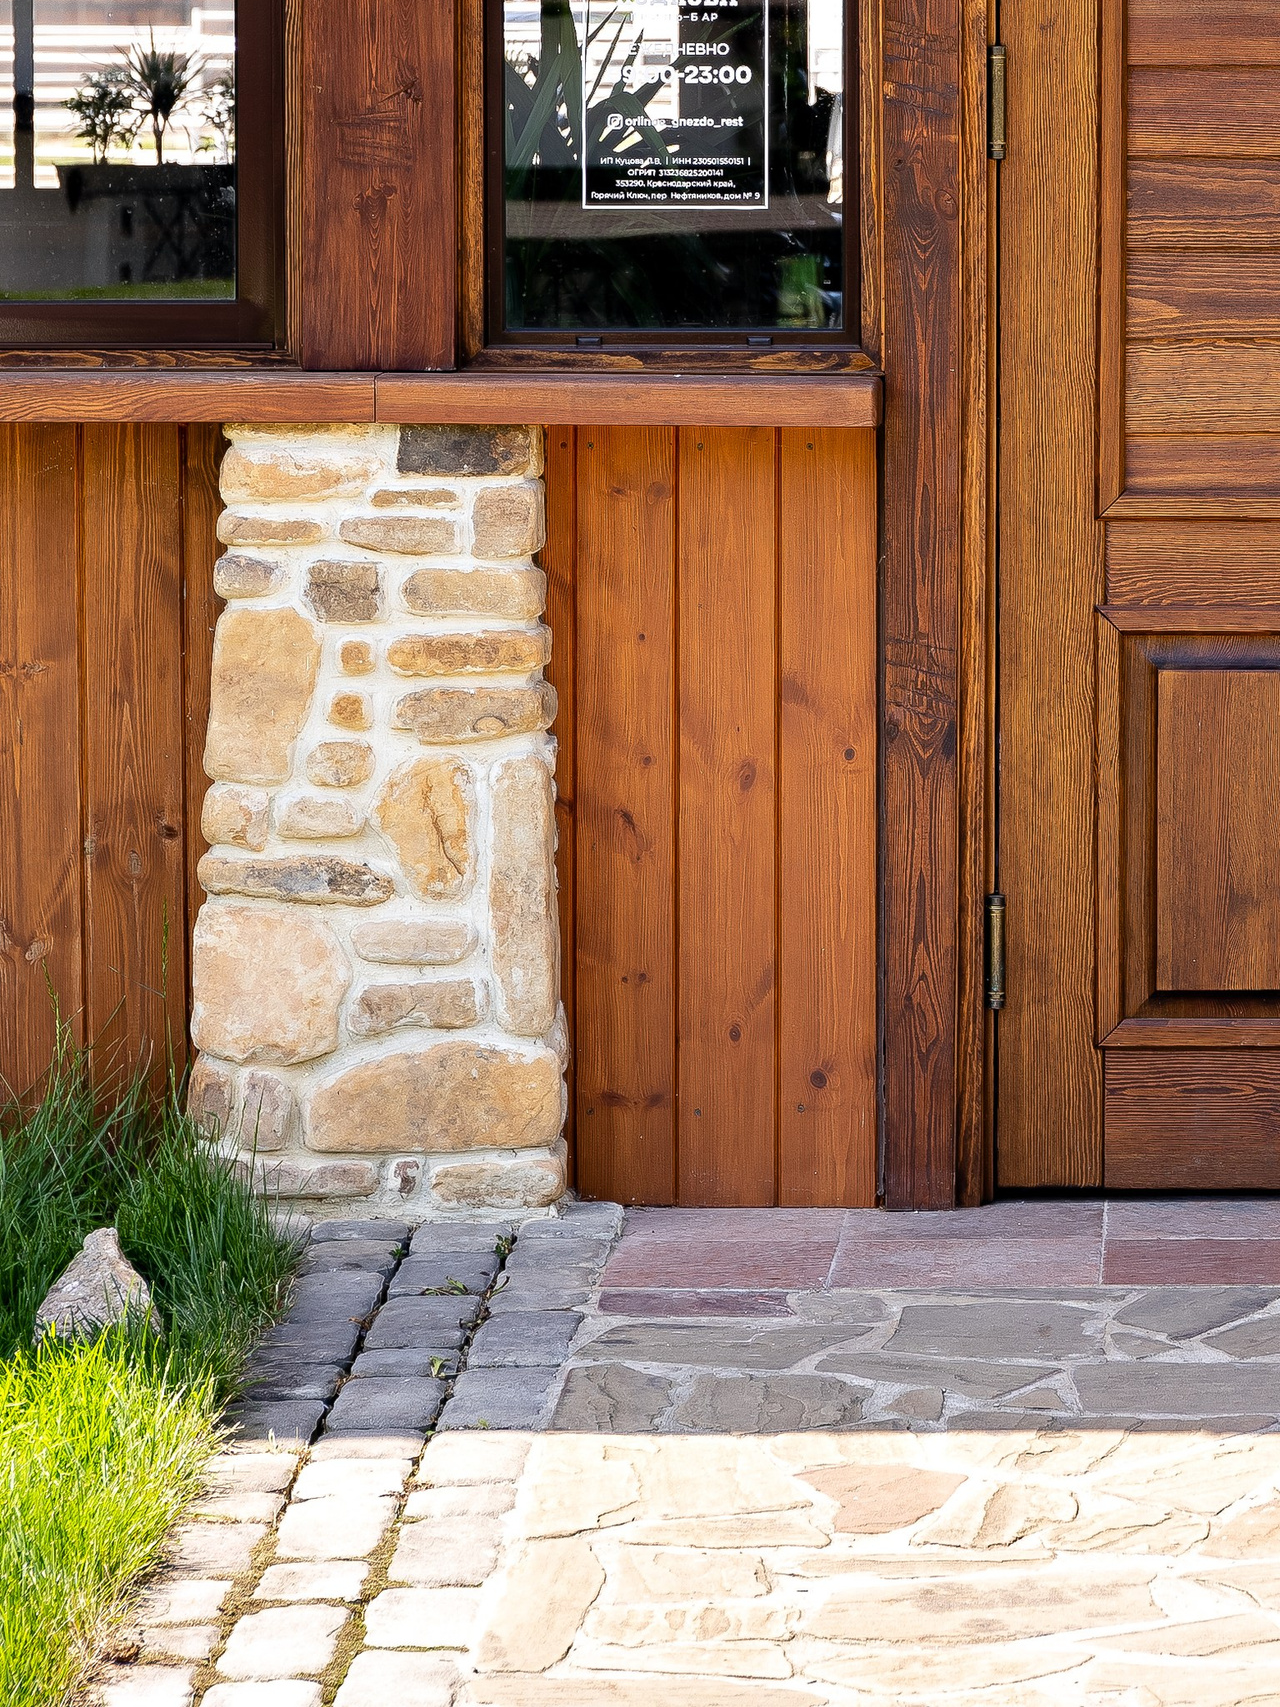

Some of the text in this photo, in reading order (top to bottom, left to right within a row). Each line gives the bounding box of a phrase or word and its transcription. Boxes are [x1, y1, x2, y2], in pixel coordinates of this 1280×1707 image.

[600, 157, 613, 165] ИП
[672, 157, 691, 165] ИНН
[627, 168, 656, 176] ОГРИП
[646, 179, 712, 189] Краснодарский
[591, 191, 625, 200] Горячий
[754, 192, 761, 200] 9
